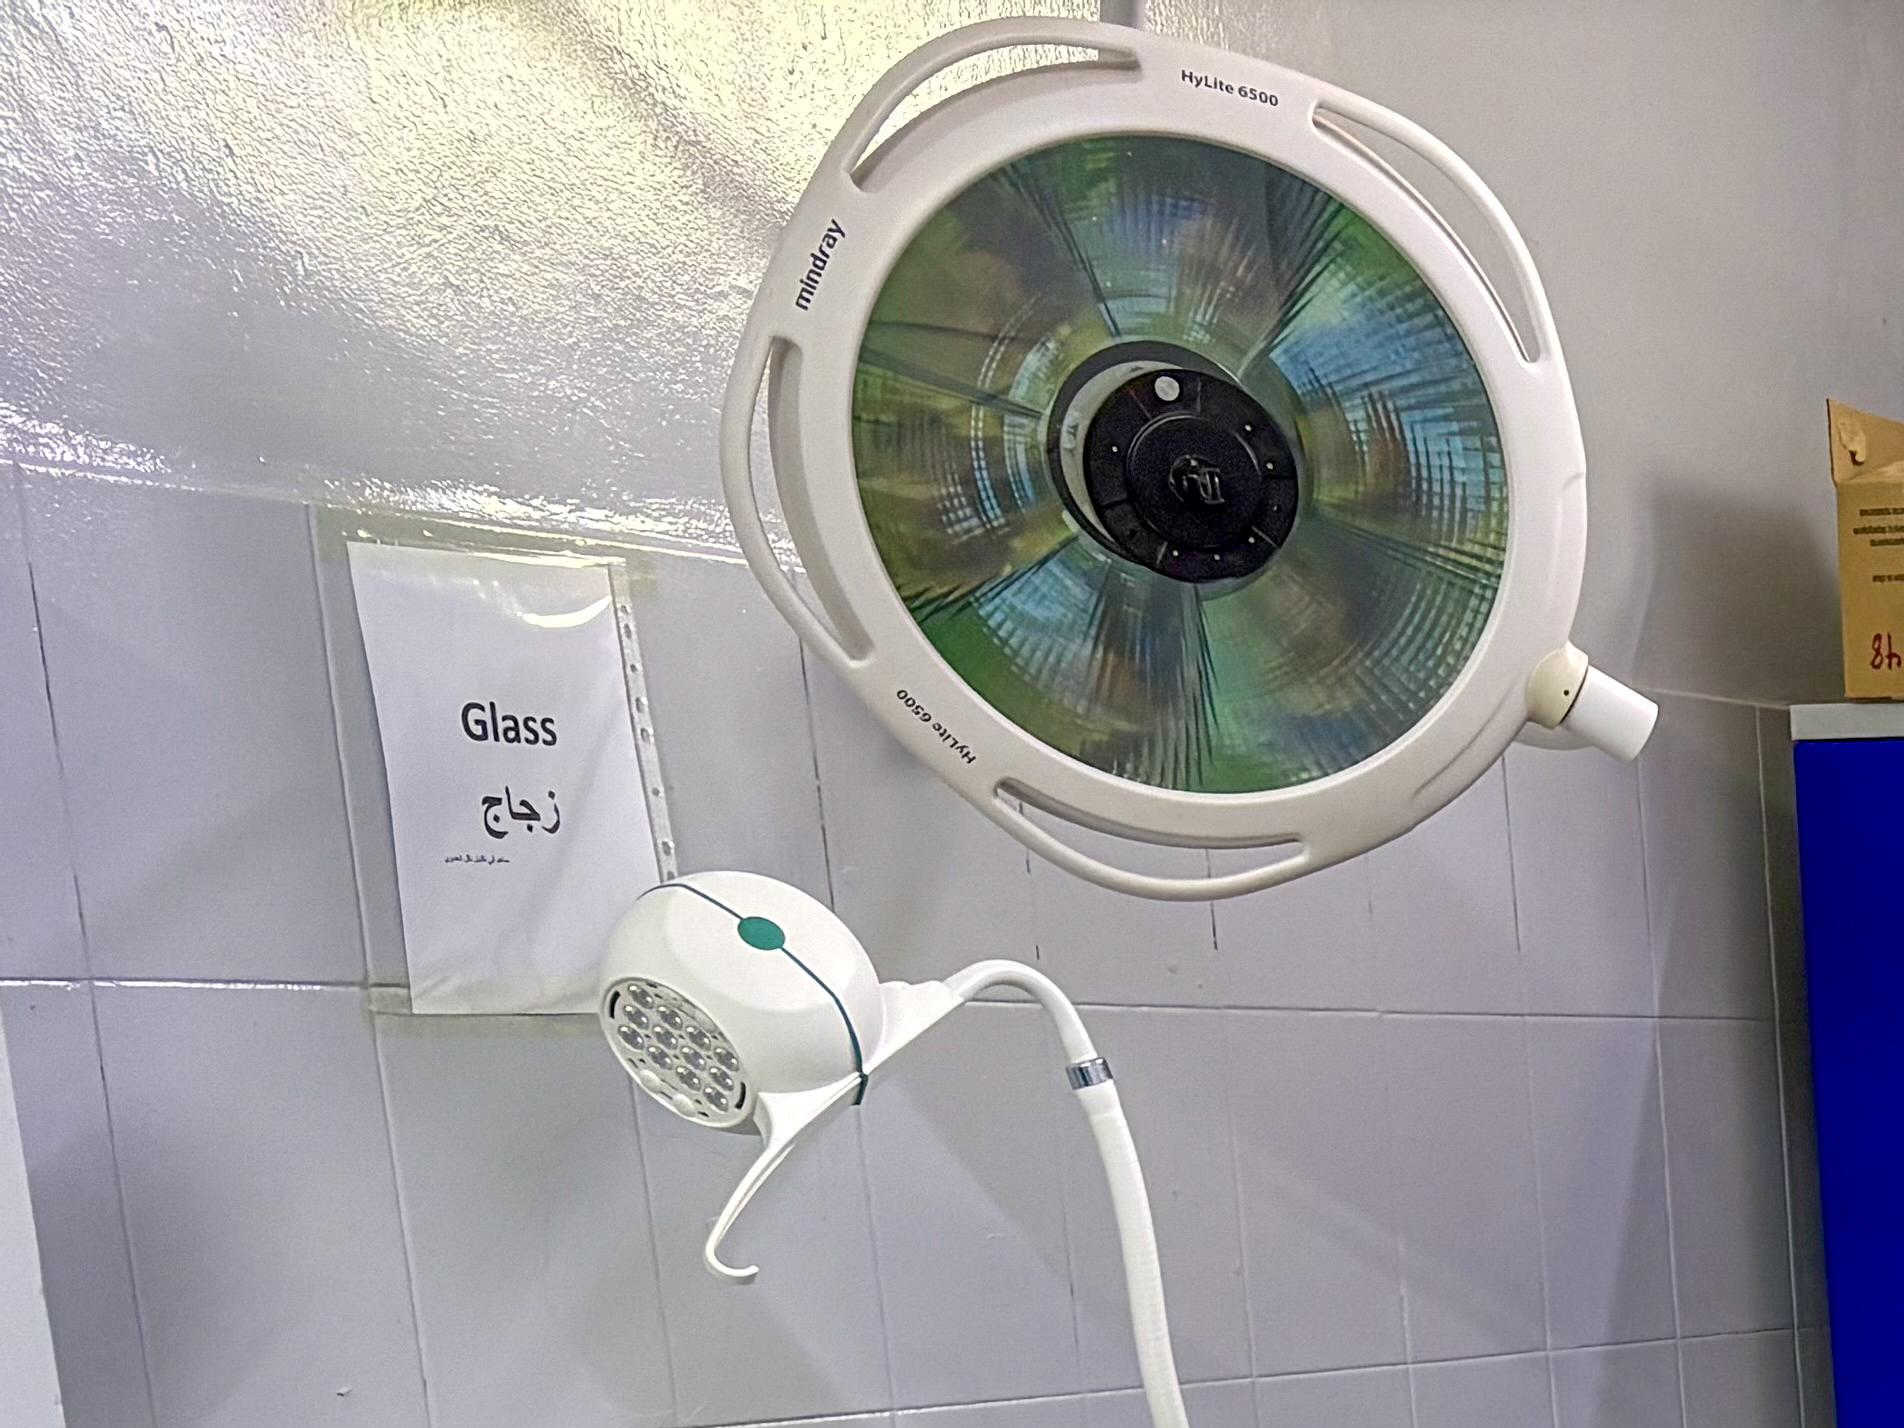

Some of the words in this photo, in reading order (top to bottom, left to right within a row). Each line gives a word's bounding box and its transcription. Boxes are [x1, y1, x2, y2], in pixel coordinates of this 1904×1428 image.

[1181, 69, 1234, 95] HyLite
[1238, 85, 1279, 107] 6500
[795, 218, 846, 311] mindray
[461, 701, 558, 746] Glass
[896, 689, 932, 723] 6500
[481, 785, 561, 839] زجاج
